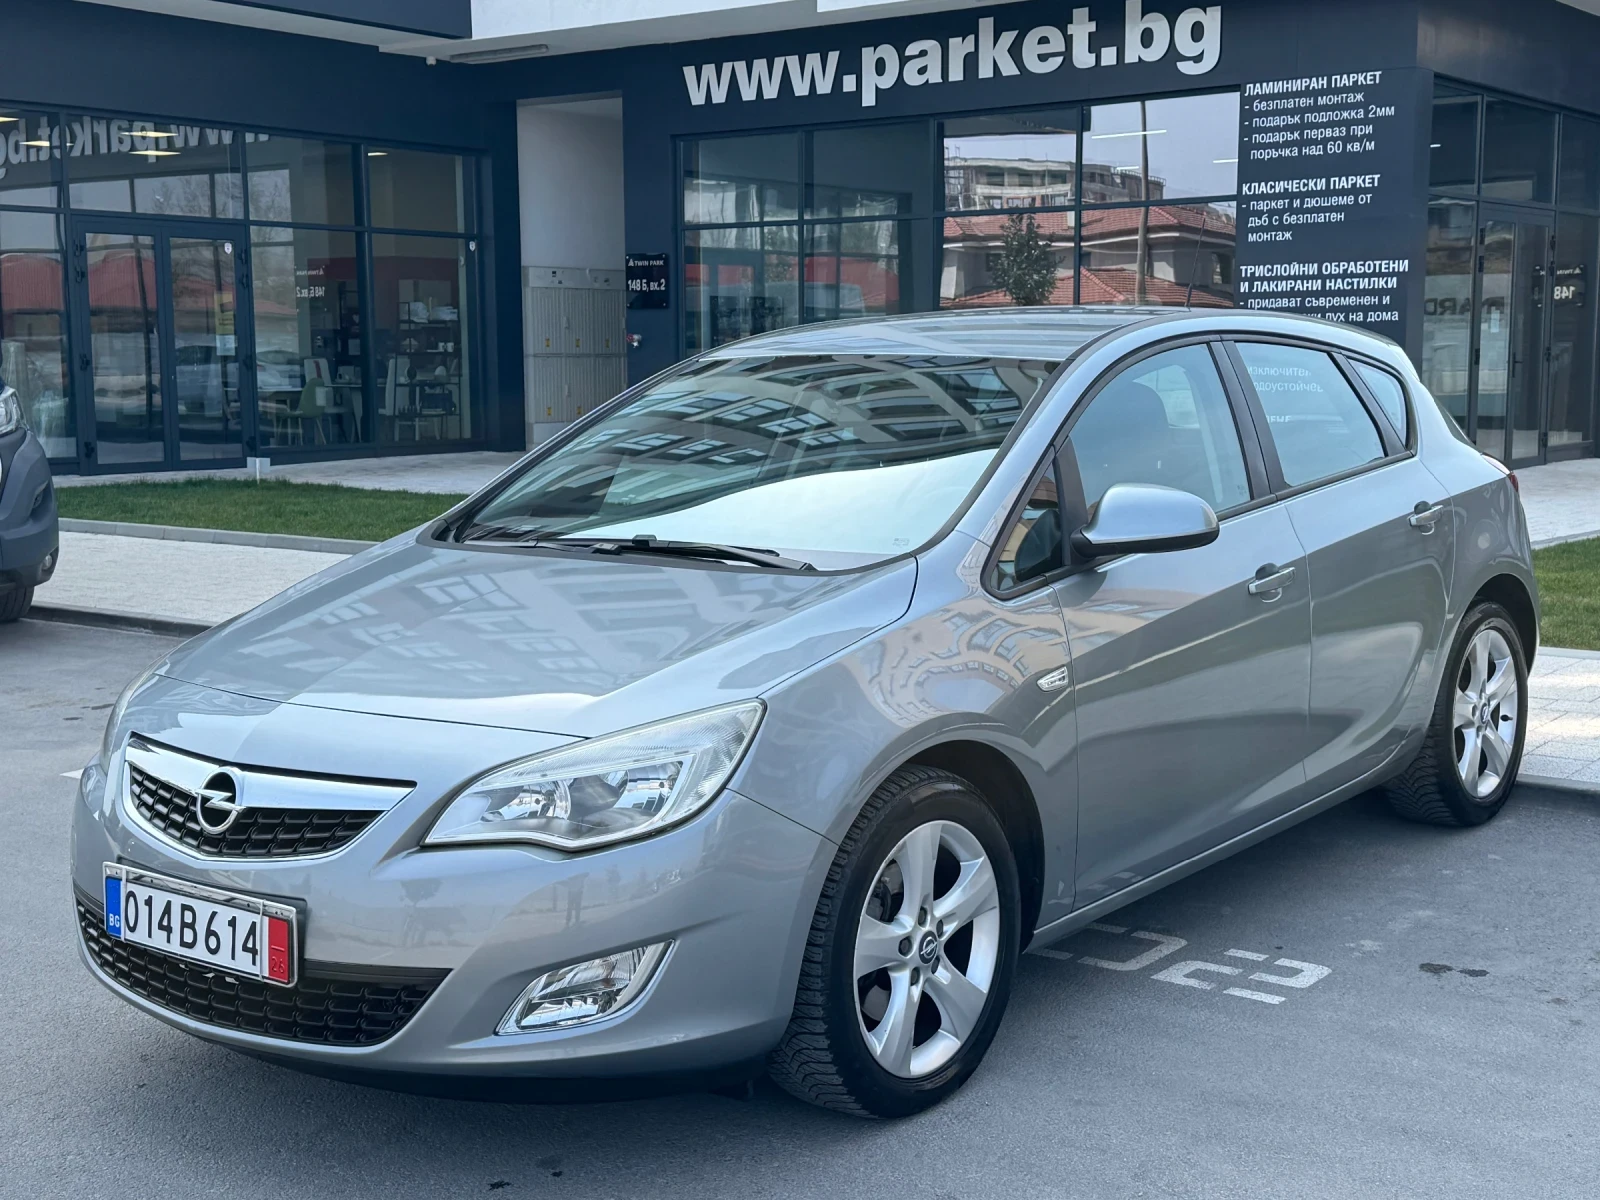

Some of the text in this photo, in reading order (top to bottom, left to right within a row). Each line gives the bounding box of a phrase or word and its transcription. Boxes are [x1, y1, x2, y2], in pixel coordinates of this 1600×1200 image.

[683, 0, 1222, 107] www.parket.bg
[1244, 71, 1382, 96] ЛАМИНИРАН ПАРКЕТ
[1253, 97, 1313, 111] безплатен
[1318, 92, 1364, 105] монтаж
[1253, 114, 1300, 127] подарък
[1304, 108, 1364, 123] подложка
[1368, 105, 1395, 117] 2мм
[1252, 131, 1300, 144] подарък
[1304, 127, 1346, 140] перваз
[1350, 124, 1372, 137] при
[1251, 138, 1374, 160] поръчка над 60 кв/м
[1242, 174, 1380, 195] КЛАСИЧЕСКИ ПАРКЕТ
[1250, 199, 1289, 212] паркет
[1293, 198, 1300, 208] и
[1303, 195, 1354, 208] дюшеме
[1358, 194, 1372, 204] от
[1248, 212, 1344, 227] дъб с безплатен
[1248, 230, 1292, 242] монтаж
[1240, 260, 1408, 277] ТРИСЛОЙНИ ОБРАБОТЕНИ
[628, 279, 641, 291] 148
[1240, 277, 1397, 292] И ЛАКИРАНИ НАСТИЛКИ
[1248, 298, 1301, 310] придават
[1305, 296, 1378, 308] съвременен
[1383, 295, 1390, 304] и
[1349, 312, 1363, 321] на
[1367, 311, 1398, 322] дома
[109, 890, 259, 966] BG 014B614
